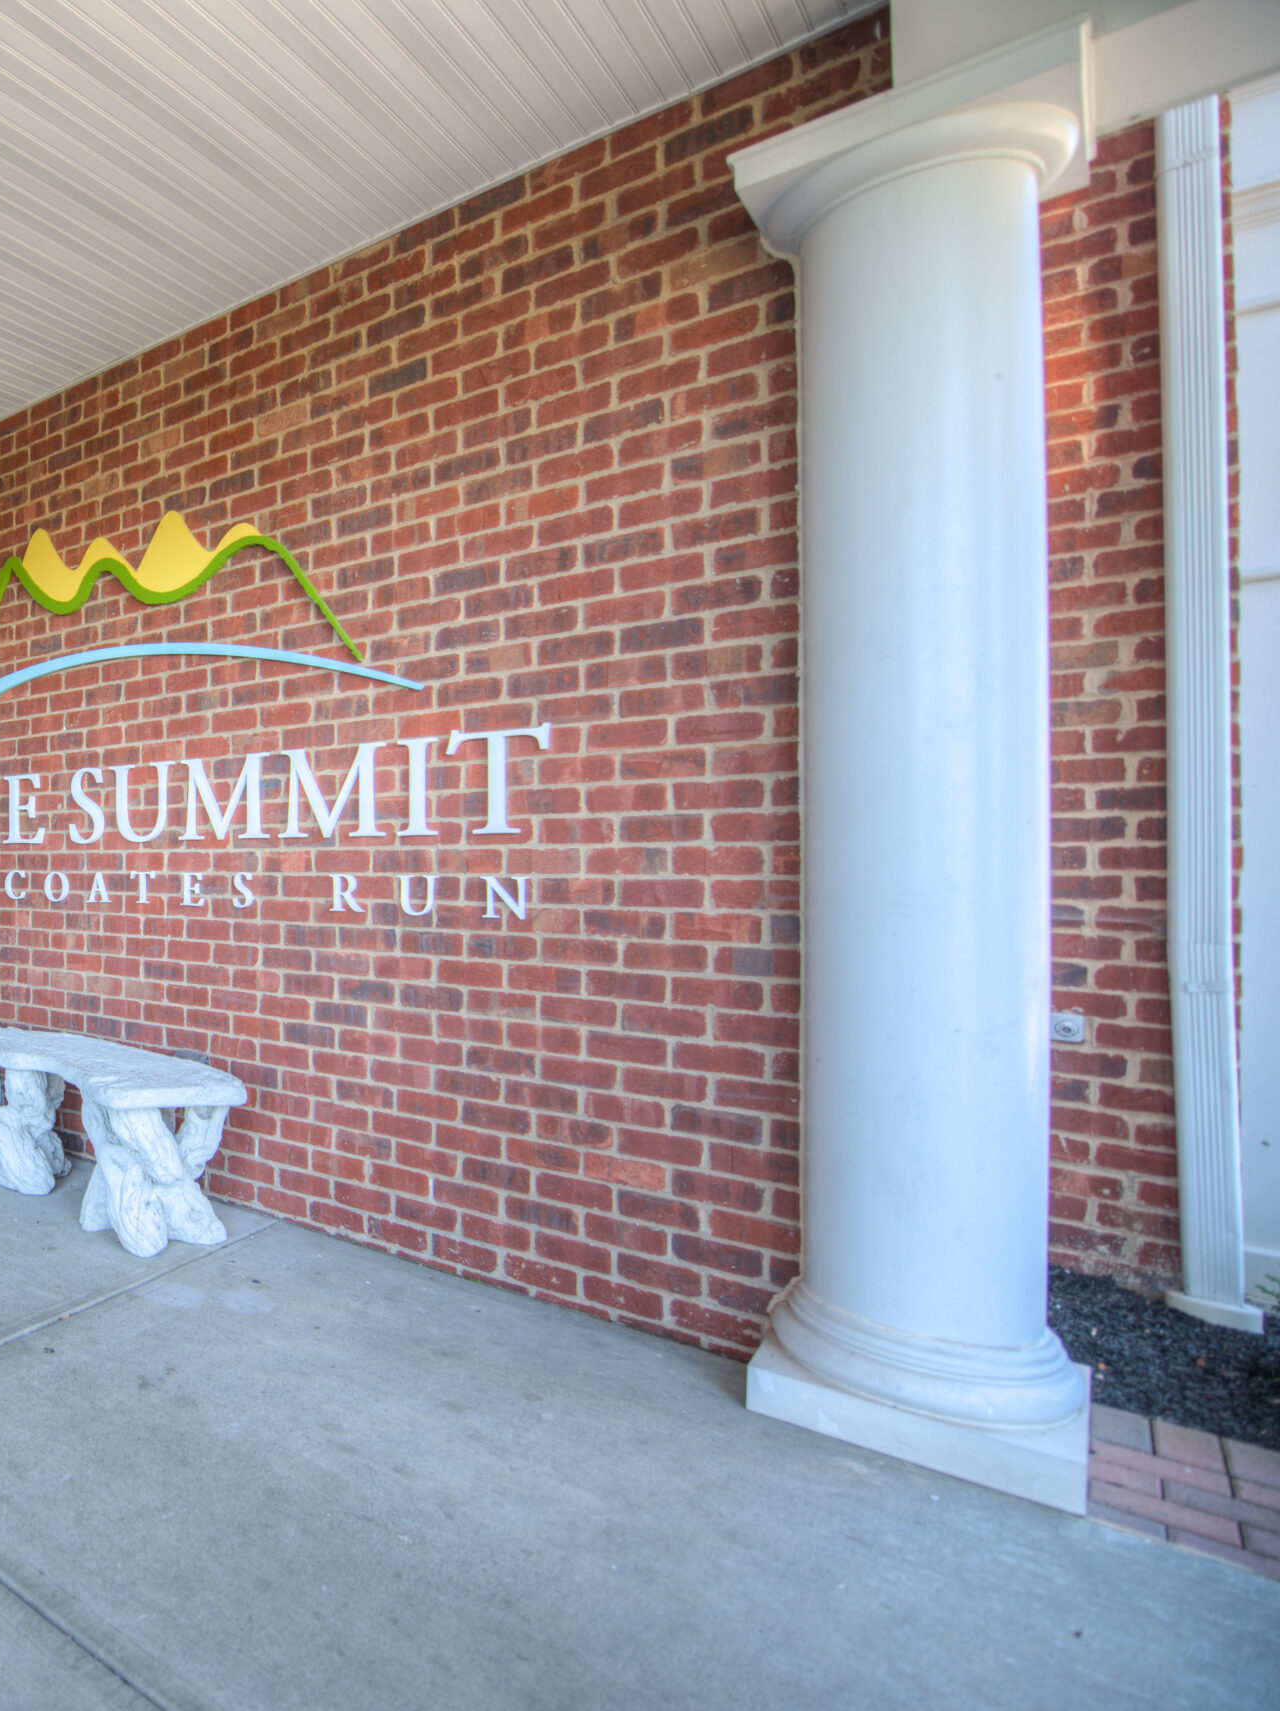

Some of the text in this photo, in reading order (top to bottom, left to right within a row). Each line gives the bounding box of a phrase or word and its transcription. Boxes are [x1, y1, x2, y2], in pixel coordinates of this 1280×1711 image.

[68, 722, 552, 845] SUMMIT
[4, 869, 256, 909] COATES
[329, 873, 531, 921] RUN
